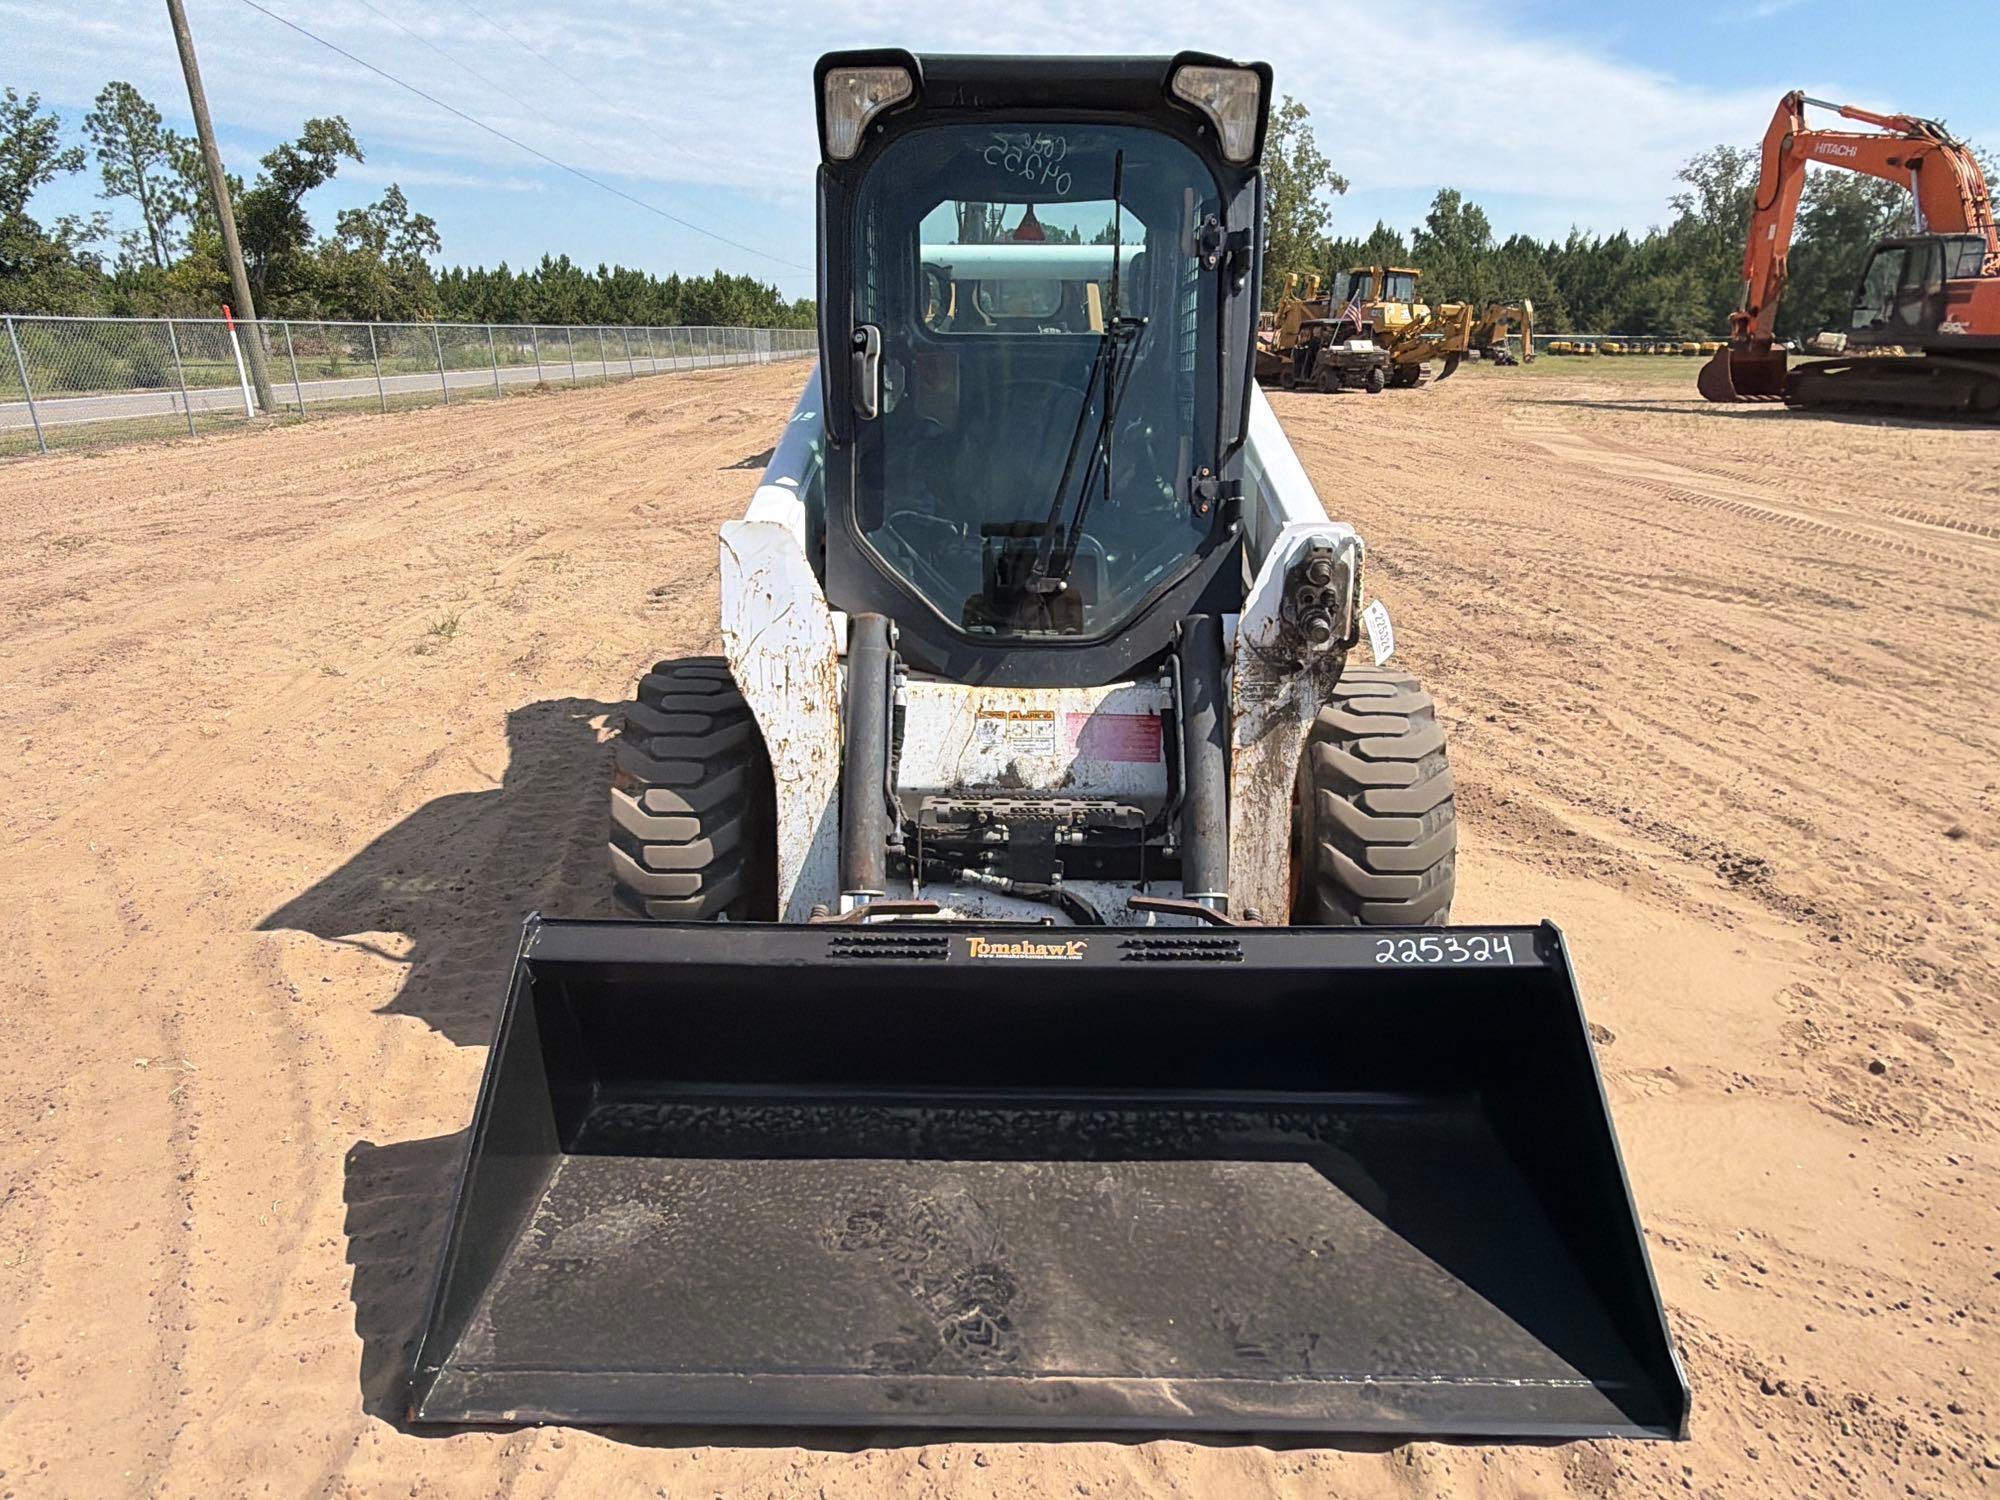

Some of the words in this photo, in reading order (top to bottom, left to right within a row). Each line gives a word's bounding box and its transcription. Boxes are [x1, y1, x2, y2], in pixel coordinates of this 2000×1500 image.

[1815, 142, 1858, 157] HITACHI
[1374, 612, 1391, 653] 225324
[1019, 711, 1052, 719] ARNNG
[966, 936, 1089, 957] Tomahawk
[1375, 936, 1514, 965] 225324
